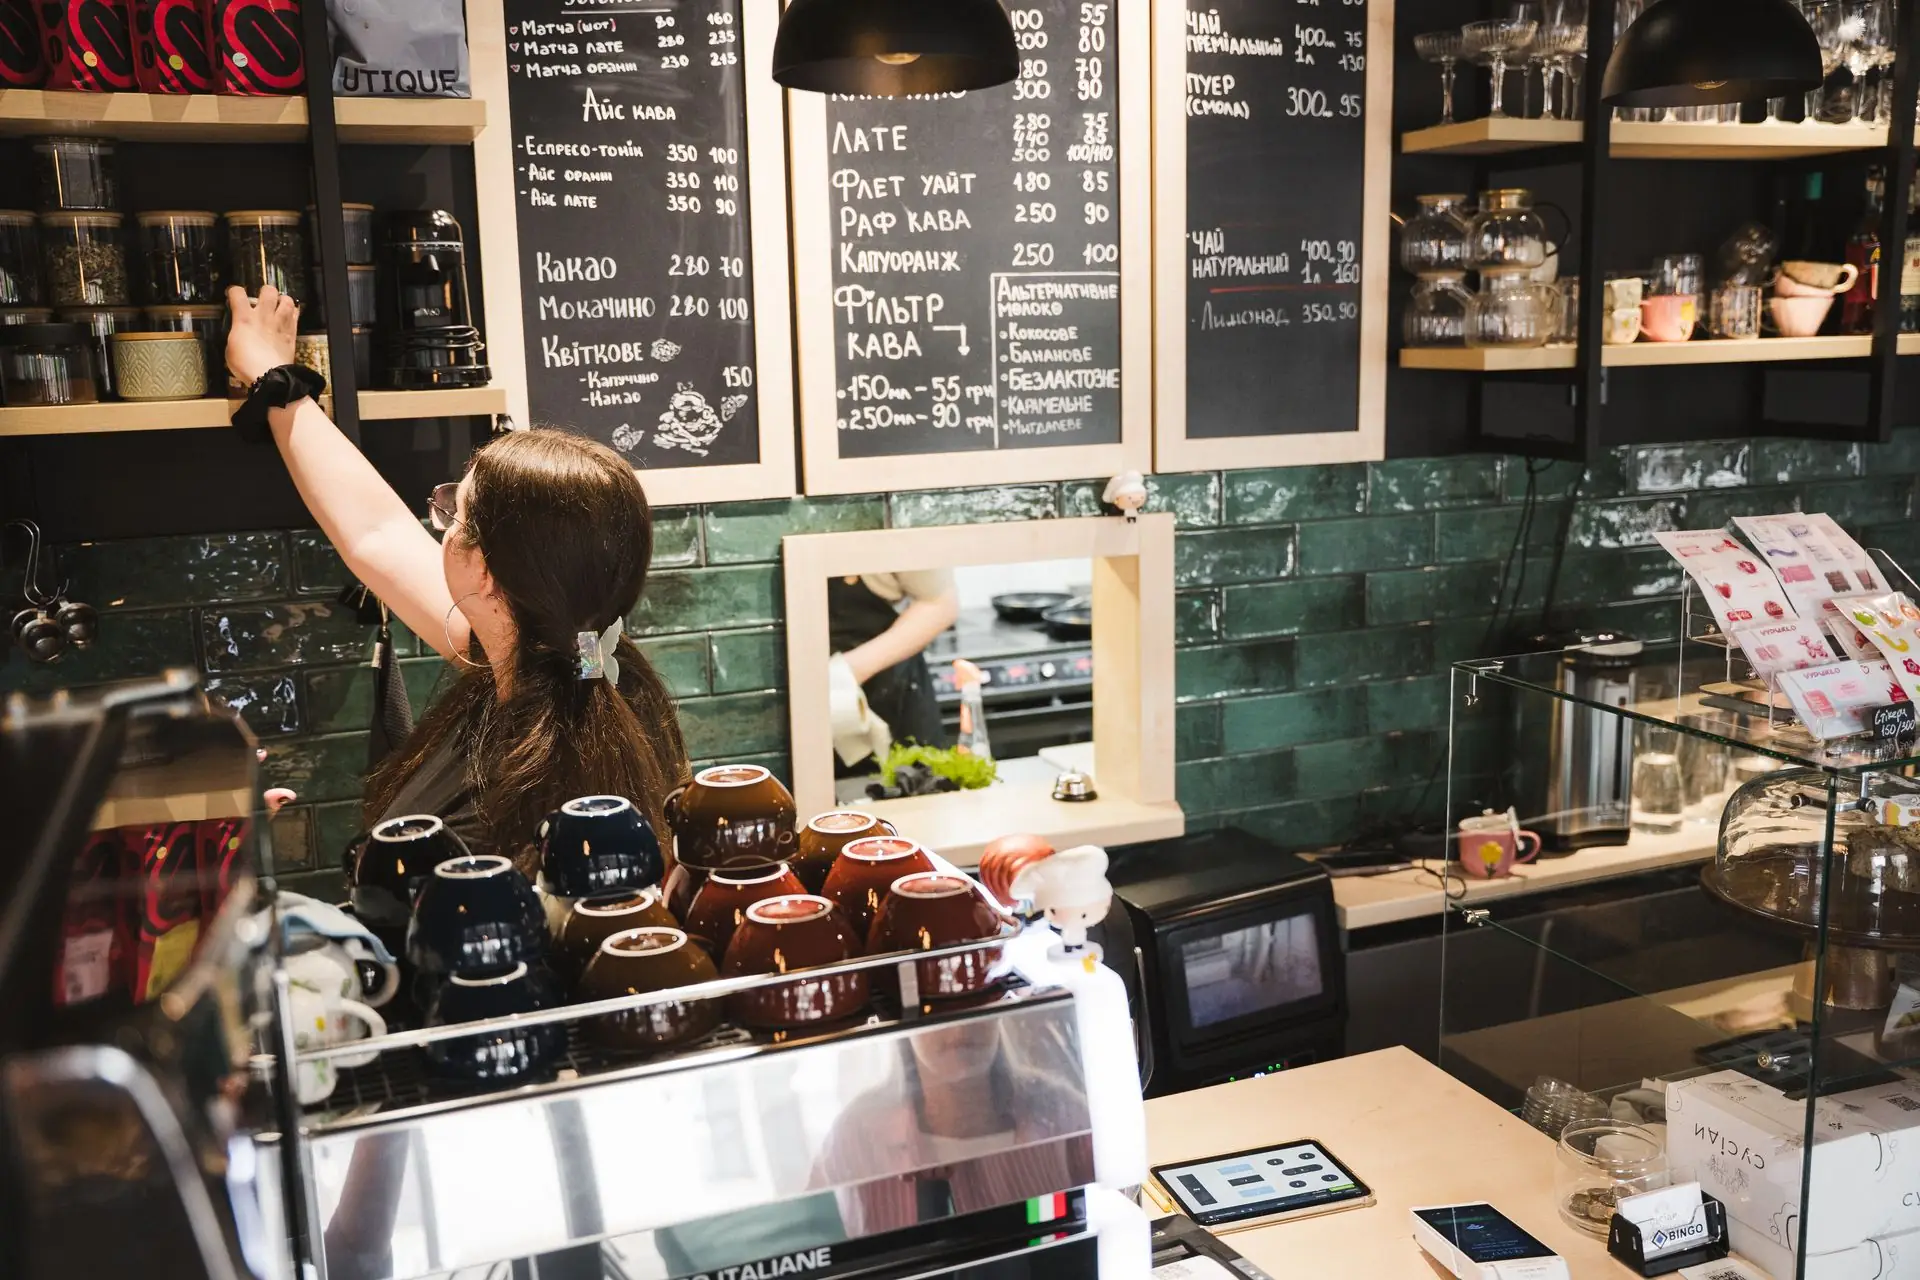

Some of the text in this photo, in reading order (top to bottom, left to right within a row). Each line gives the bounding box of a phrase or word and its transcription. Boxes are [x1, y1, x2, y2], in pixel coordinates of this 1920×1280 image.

[521, 20, 574, 36] Матча
[1010, 3, 1108, 31] 100 55
[1186, 9, 1220, 35] ЧАЙ
[523, 41, 579, 56] Матча
[658, 34, 685, 48] 280
[708, 30, 736, 45] 235
[1079, 25, 1105, 53] 80
[526, 62, 582, 78] Матча
[661, 54, 689, 69] 230
[1075, 57, 1102, 80] 70
[1012, 79, 1103, 101] 300 90
[1186, 72, 1236, 96] ПУЕР
[1340, 94, 1362, 118] 95
[1013, 112, 1051, 131] 280
[1013, 129, 1049, 148] 440
[666, 143, 698, 163] 350
[708, 146, 738, 165] 100
[1012, 147, 1051, 162] 500
[666, 171, 700, 189] 350
[712, 174, 739, 192] 110
[1013, 172, 1050, 192] 180
[1082, 171, 1109, 193] 85
[666, 194, 701, 213] 350
[715, 198, 737, 216] 90
[1014, 202, 1057, 224] 250
[1084, 202, 1110, 225] 90
[1192, 228, 1225, 255] ЧАЙ
[1012, 243, 1054, 266] 250
[1082, 244, 1119, 266] 100
[1192, 252, 1289, 278] НАТУРАЛЬНИЙ
[1337, 240, 1356, 264] 90
[536, 252, 744, 283] Какао 280 70
[1332, 263, 1360, 284] 160
[669, 295, 709, 317] 280
[717, 297, 749, 320] 100
[1339, 302, 1358, 320] 90
[722, 365, 753, 388] 150
[931, 376, 961, 402] 55
[932, 402, 961, 428] 90
[1669, 1223, 1704, 1241] BINGO
